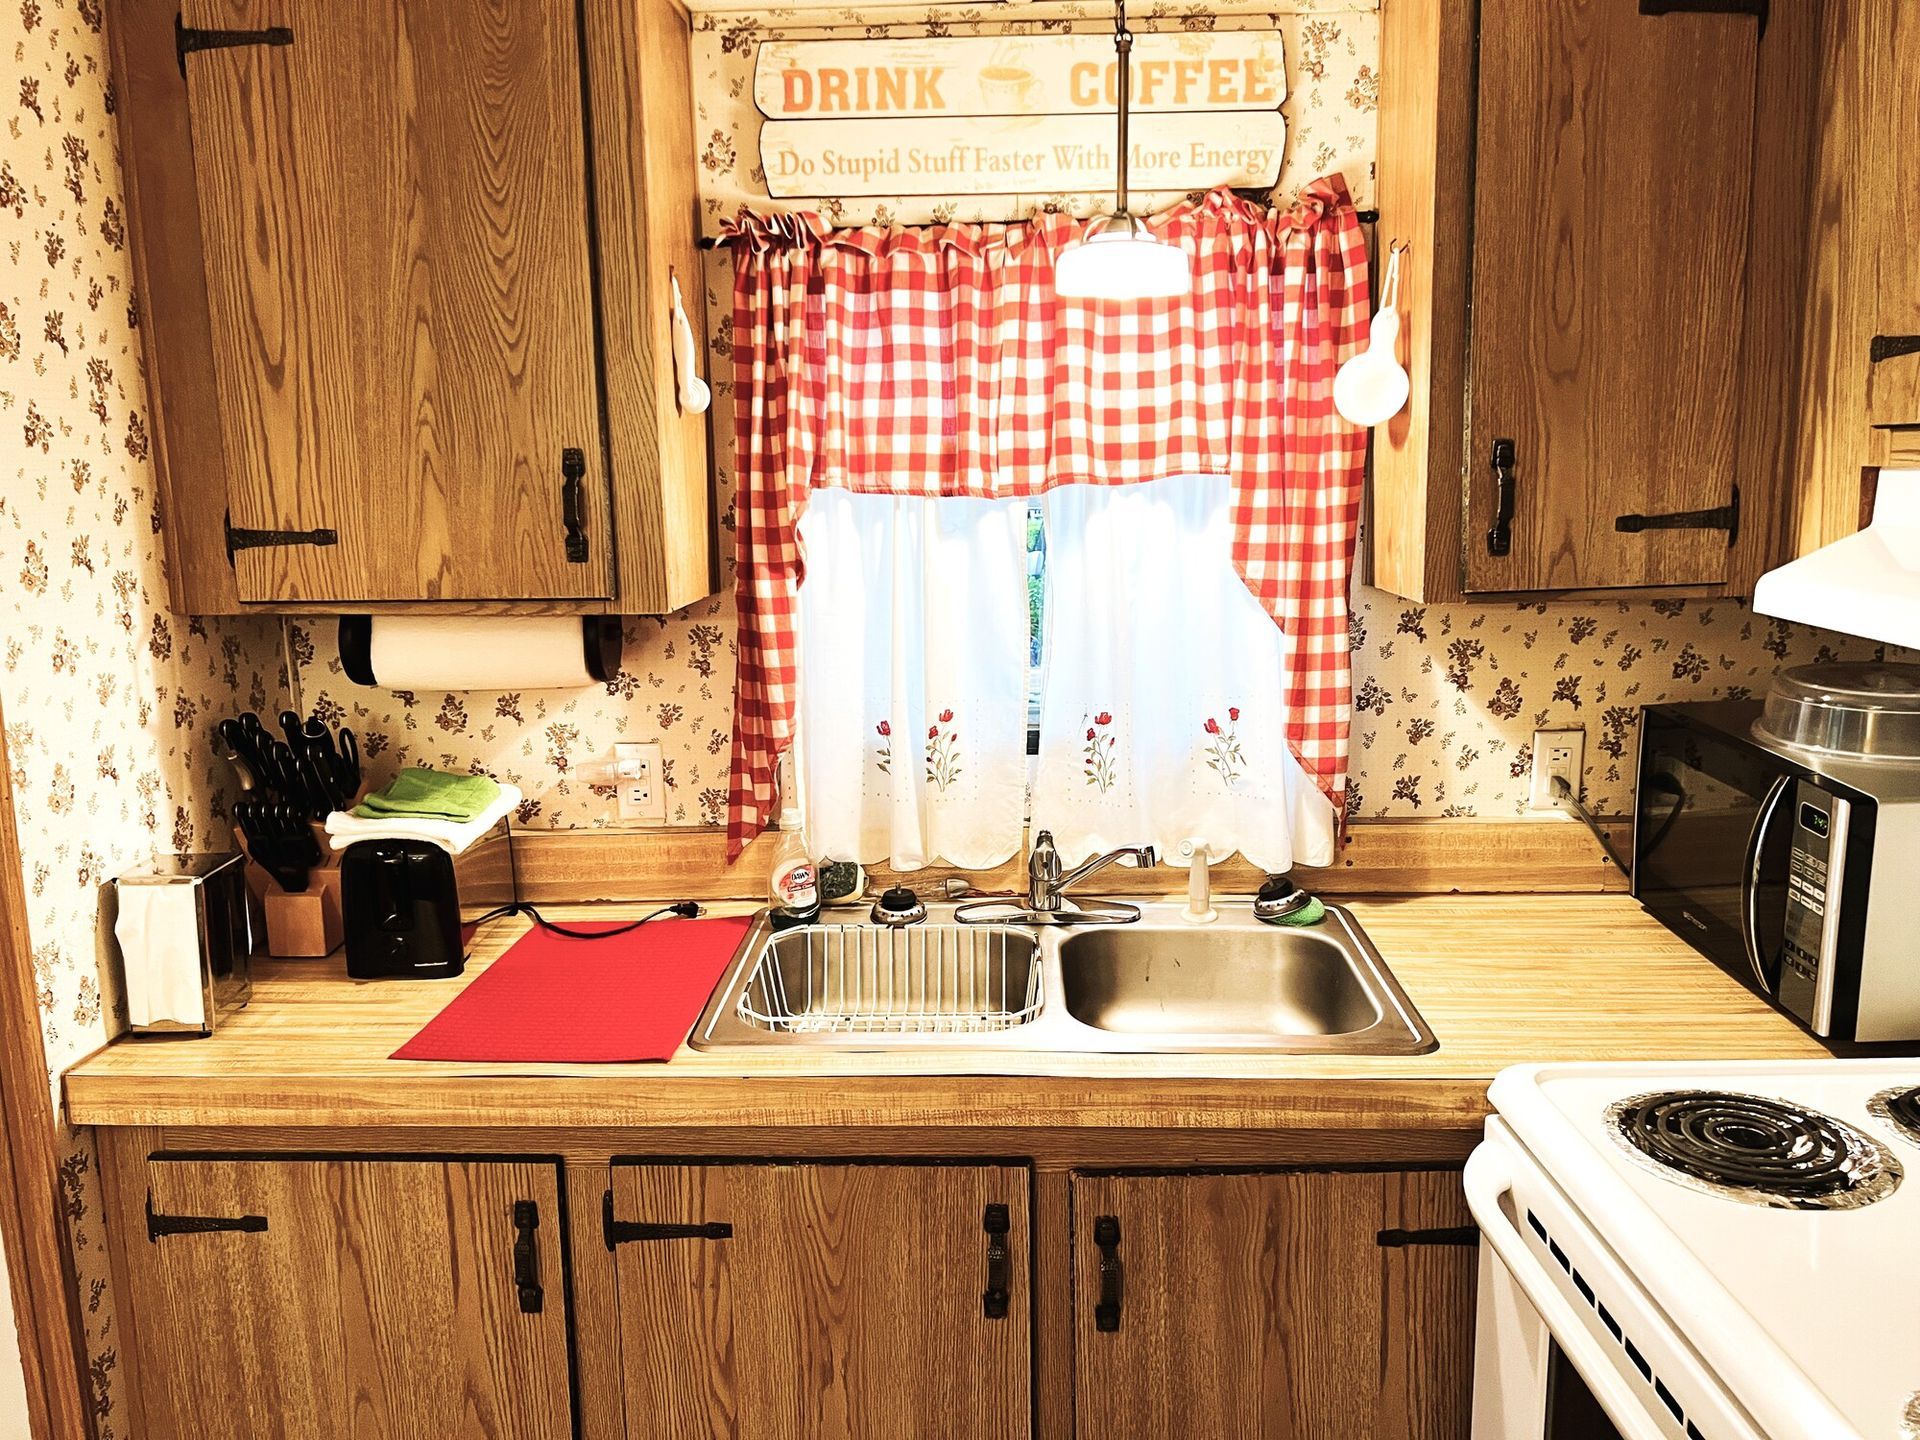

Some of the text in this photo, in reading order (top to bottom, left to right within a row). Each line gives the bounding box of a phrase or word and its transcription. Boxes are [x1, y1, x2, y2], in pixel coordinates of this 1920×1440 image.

[782, 58, 1276, 112] DRINK COFFEE
[778, 150, 815, 177] Do
[823, 148, 899, 183] Stupid
[908, 145, 970, 175] Stuff
[974, 146, 1046, 173] Faster
[1052, 143, 1111, 171] With
[1189, 142, 1274, 175] Energy
